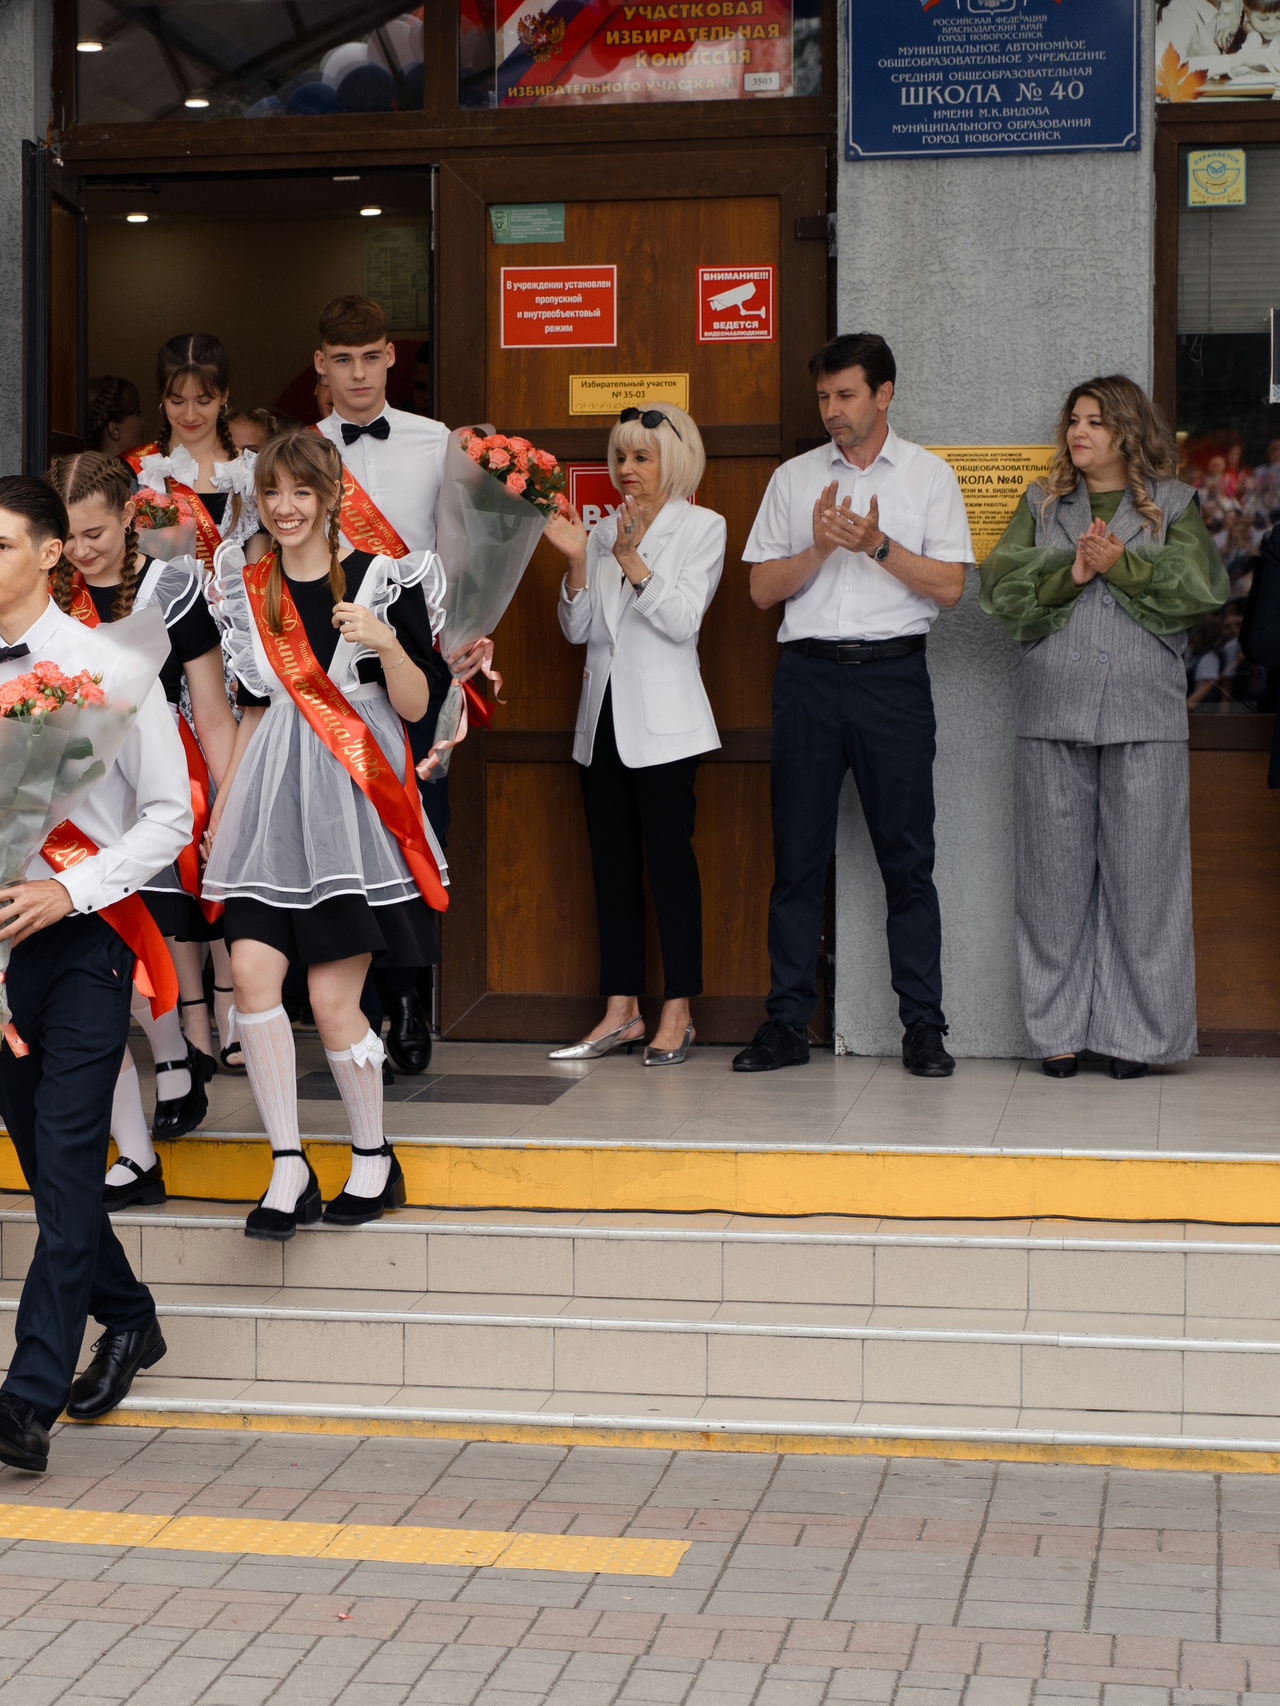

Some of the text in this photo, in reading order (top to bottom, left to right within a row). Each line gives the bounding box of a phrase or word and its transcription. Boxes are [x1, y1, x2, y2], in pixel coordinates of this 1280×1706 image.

[624, 0, 763, 21] УЧАСТКОВАЯ
[933, 14, 1048, 26] РОССИЙСКАЯ ФЕДЕРАЦИЯ
[942, 21, 1043, 33] КРАСНОДАРСКИЙ КРАЙ
[606, 23, 780, 46] ИЗБИРАТЕЛЬНАЯ
[937, 31, 1043, 43] ГОРОД НОВОРОССИЙСК
[898, 40, 1086, 56] МУНИЦИПАЛЬНОЕ АВТОНОМНОЕ
[635, 49, 751, 68] КОМИССИЯ
[878, 50, 1106, 68] ОБЩЕОБРАЗОВАТЕЛЬНОЕ УЧРЕЖДЕНИЕ
[891, 66, 1093, 83] СРЕДНЯЯ ОБЩЕОБРАЗОВАТЕЛЬНАЯ
[508, 80, 642, 98] ИЗБИРАТЕЛЬНОГО
[646, 78, 714, 93] УЧАСТКА
[752, 77, 773, 86] 3503
[900, 84, 1002, 106] ШКОЛА
[1050, 80, 1084, 100] 40
[933, 106, 1050, 119] ИМЕНИ М.К.ВИДОВА
[892, 118, 1091, 133] МУНИЦИПАЛЬНОГО ОБРАЗОВАНИЯ
[922, 130, 1061, 144] ГОРОД НОВОРОССИЙСК
[703, 271, 769, 281] ВНИМАНИЕ!!!
[506, 280, 611, 291] В учреждении установлен
[535, 294, 582, 305] пропускной
[545, 325, 572, 334] режим
[713, 321, 758, 330] ВЕДЕТСЯ
[581, 380, 677, 389] Избирательный участок
[624, 391, 646, 399] 35-03
[359, 499, 395, 544] Макаренко
[299, 640, 351, 716] Винокурова Арина
[341, 738, 388, 781] 2026
